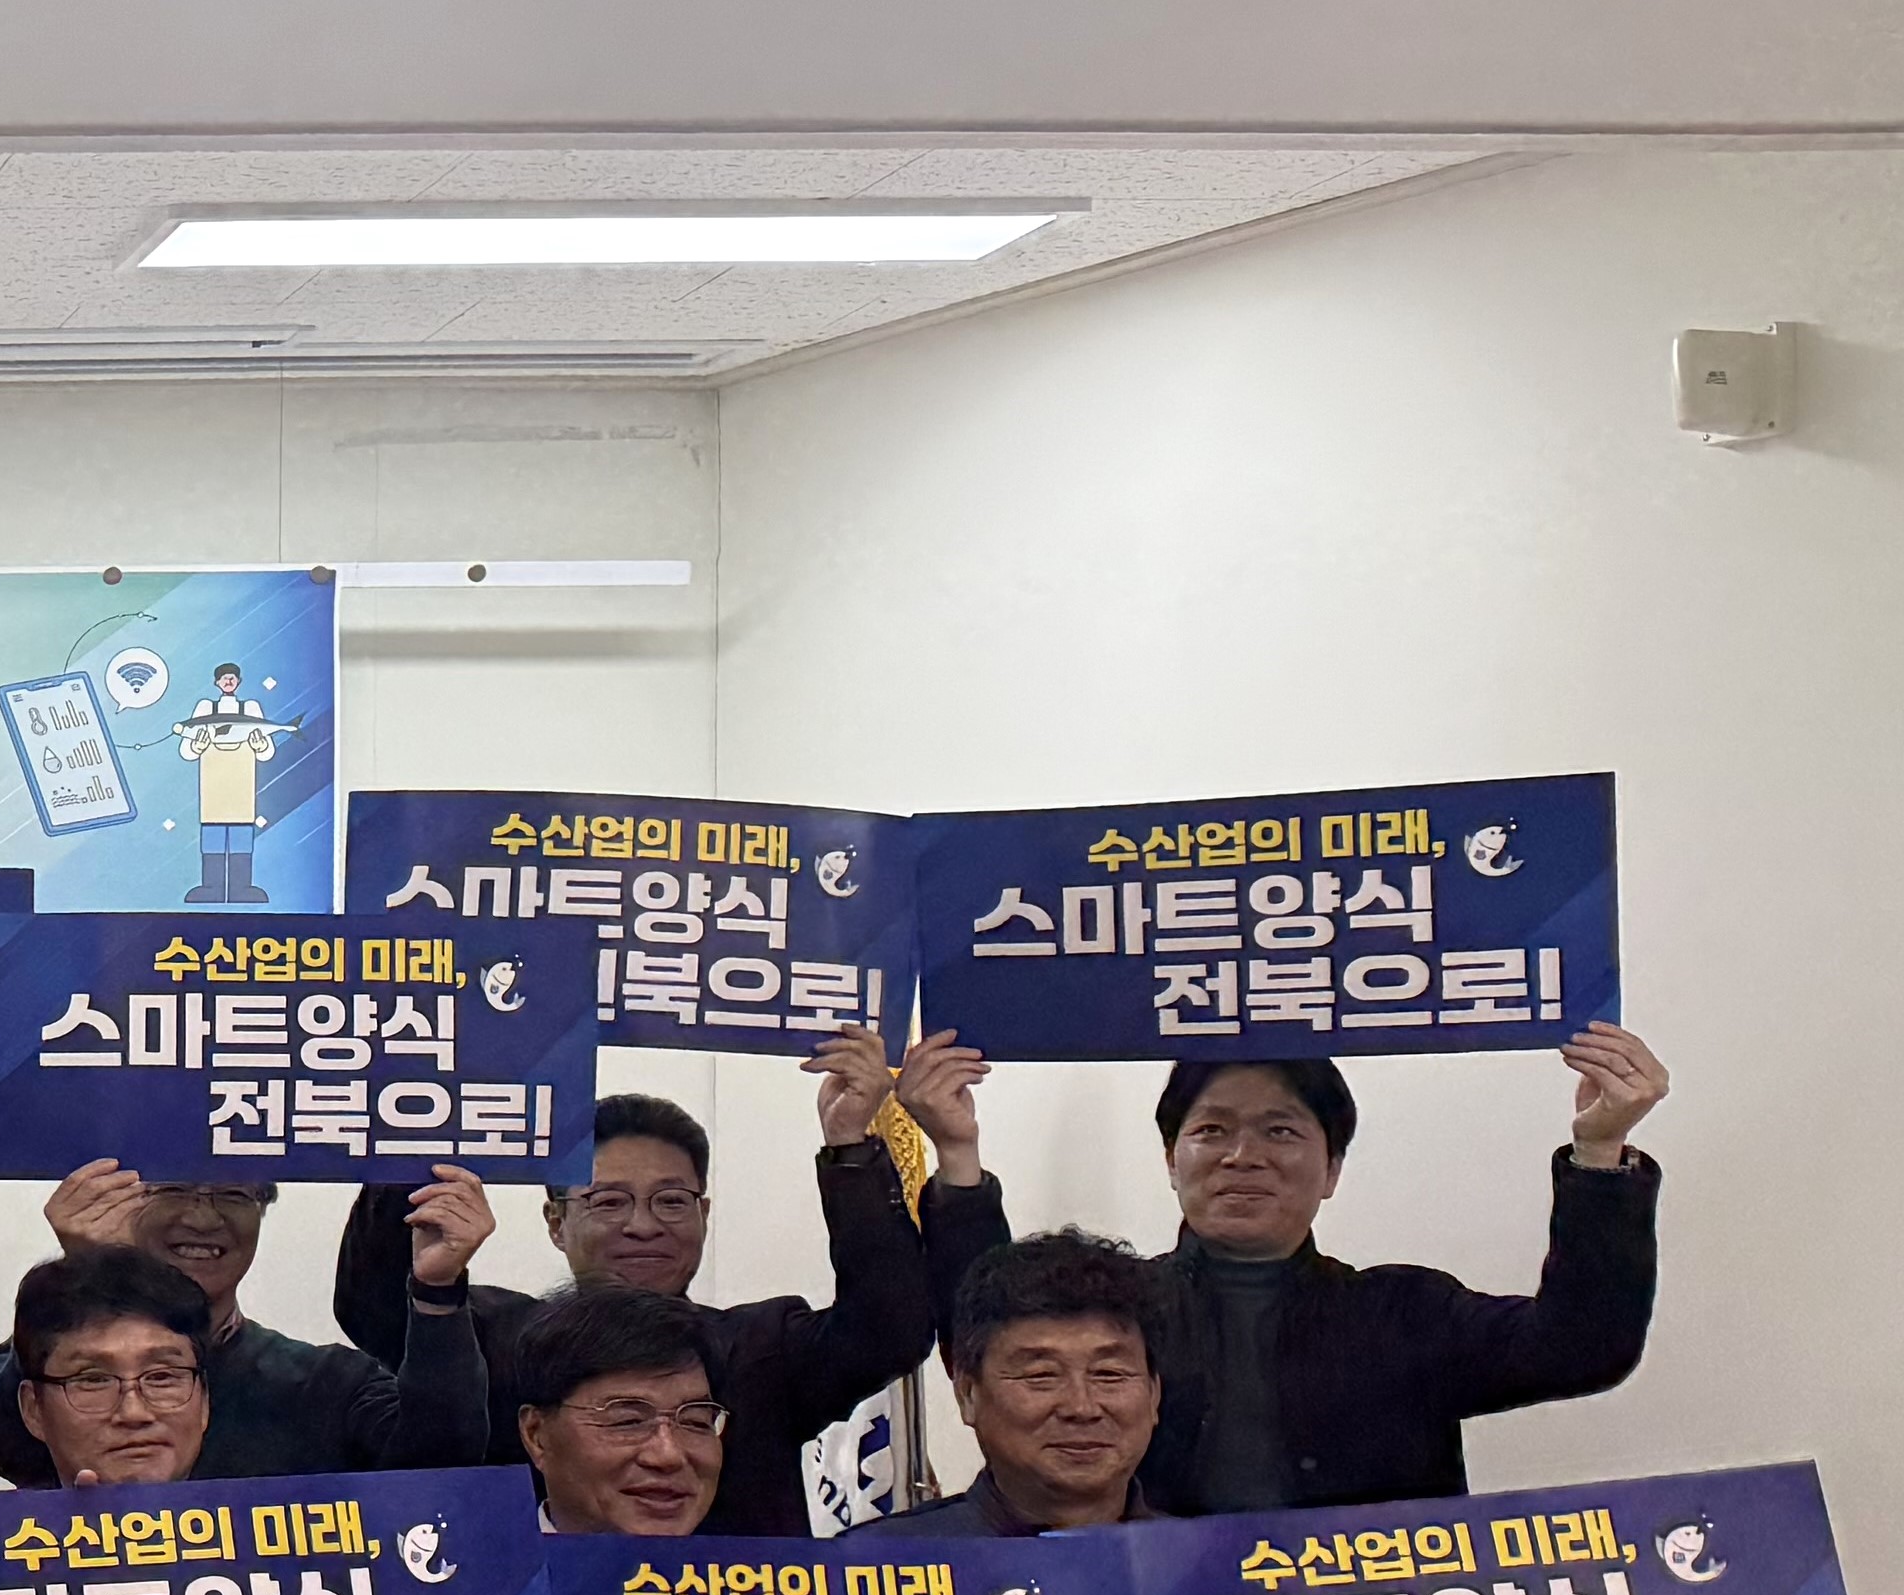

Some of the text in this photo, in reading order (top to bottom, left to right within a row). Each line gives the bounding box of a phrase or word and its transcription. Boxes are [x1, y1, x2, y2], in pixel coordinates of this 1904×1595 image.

[490, 812, 800, 873] 수산업의 미래,
[1088, 808, 1445, 871] 수산업의 미래,
[973, 866, 1432, 957] 스마트양식
[154, 936, 465, 989] 수산업의 미래,
[597, 948, 881, 1031] 북으로!
[1154, 946, 1561, 1036] 전북으로!
[38, 992, 455, 1072] 스마트양식
[208, 1080, 552, 1158] 전북으로!
[4, 1500, 381, 1571] 수산업의 미래,
[1240, 1508, 1638, 1590] 수산업의 미래,
